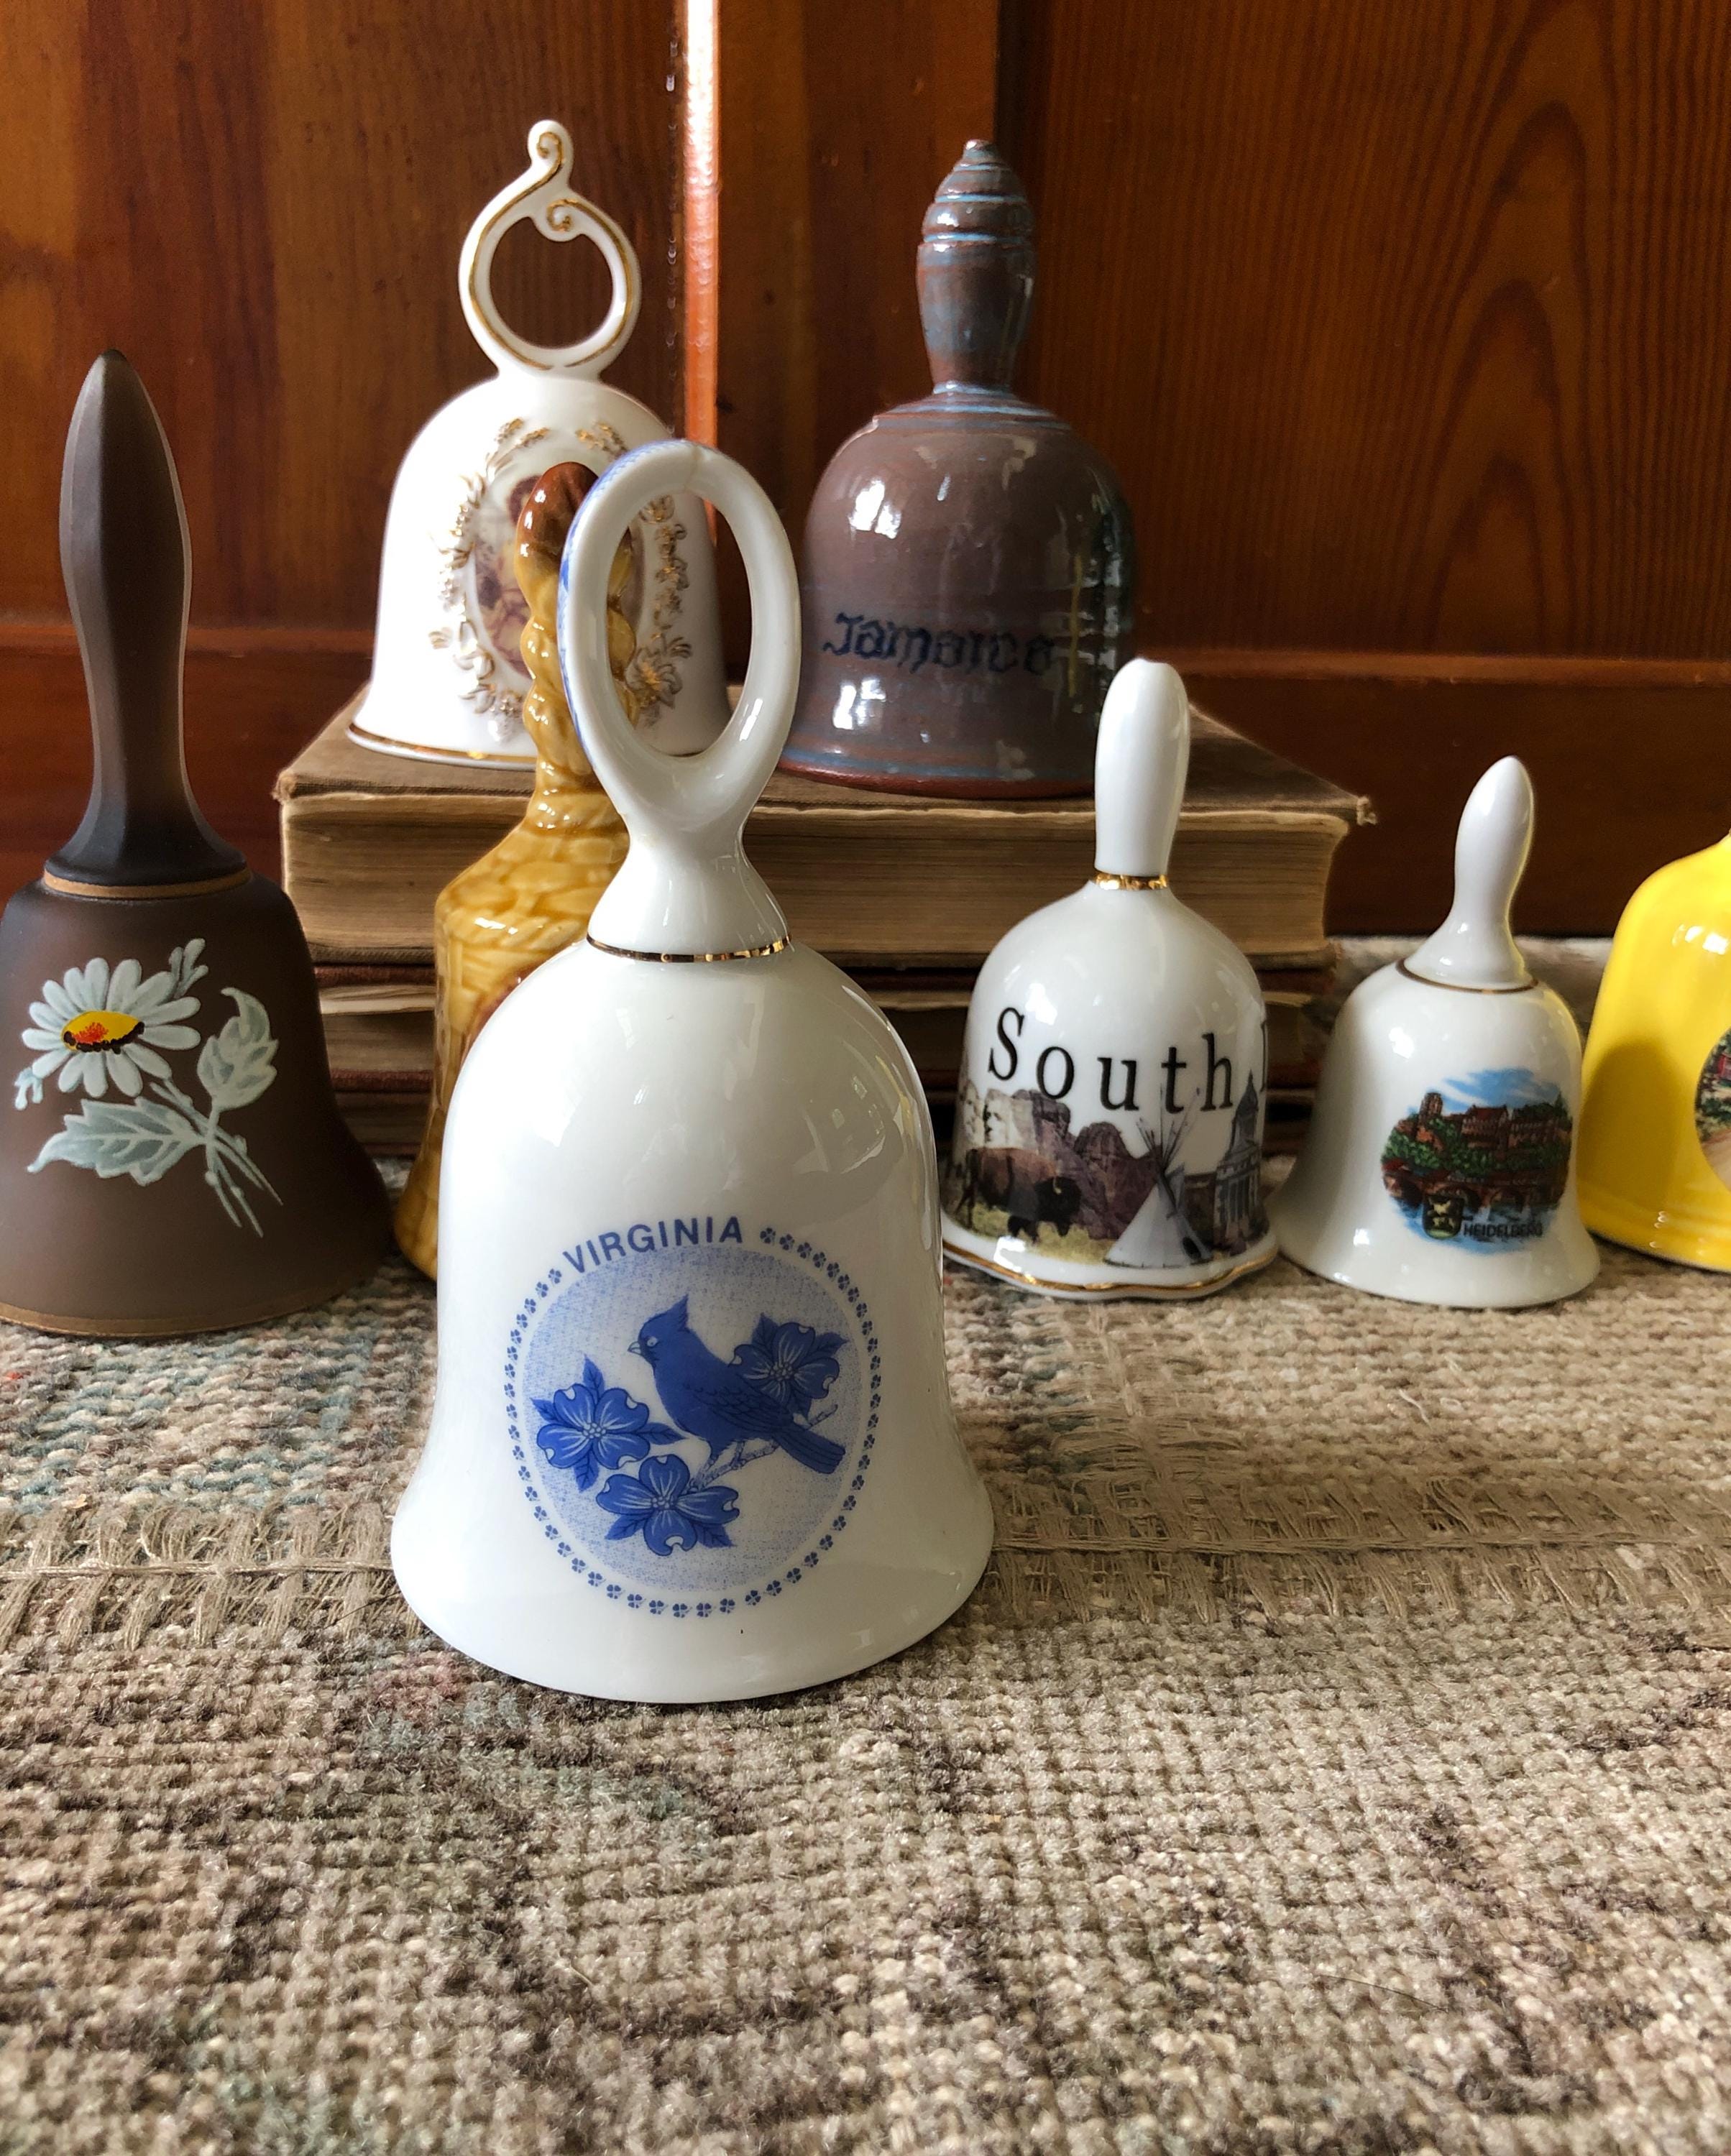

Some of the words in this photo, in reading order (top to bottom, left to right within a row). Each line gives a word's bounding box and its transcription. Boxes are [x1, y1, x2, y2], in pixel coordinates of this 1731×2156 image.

[822, 611, 1056, 676] Jamaica
[988, 1006, 1234, 1115] South
[562, 1216, 743, 1273] VIRGINIA
[1463, 1222, 1543, 1238] HEIDELBERG
